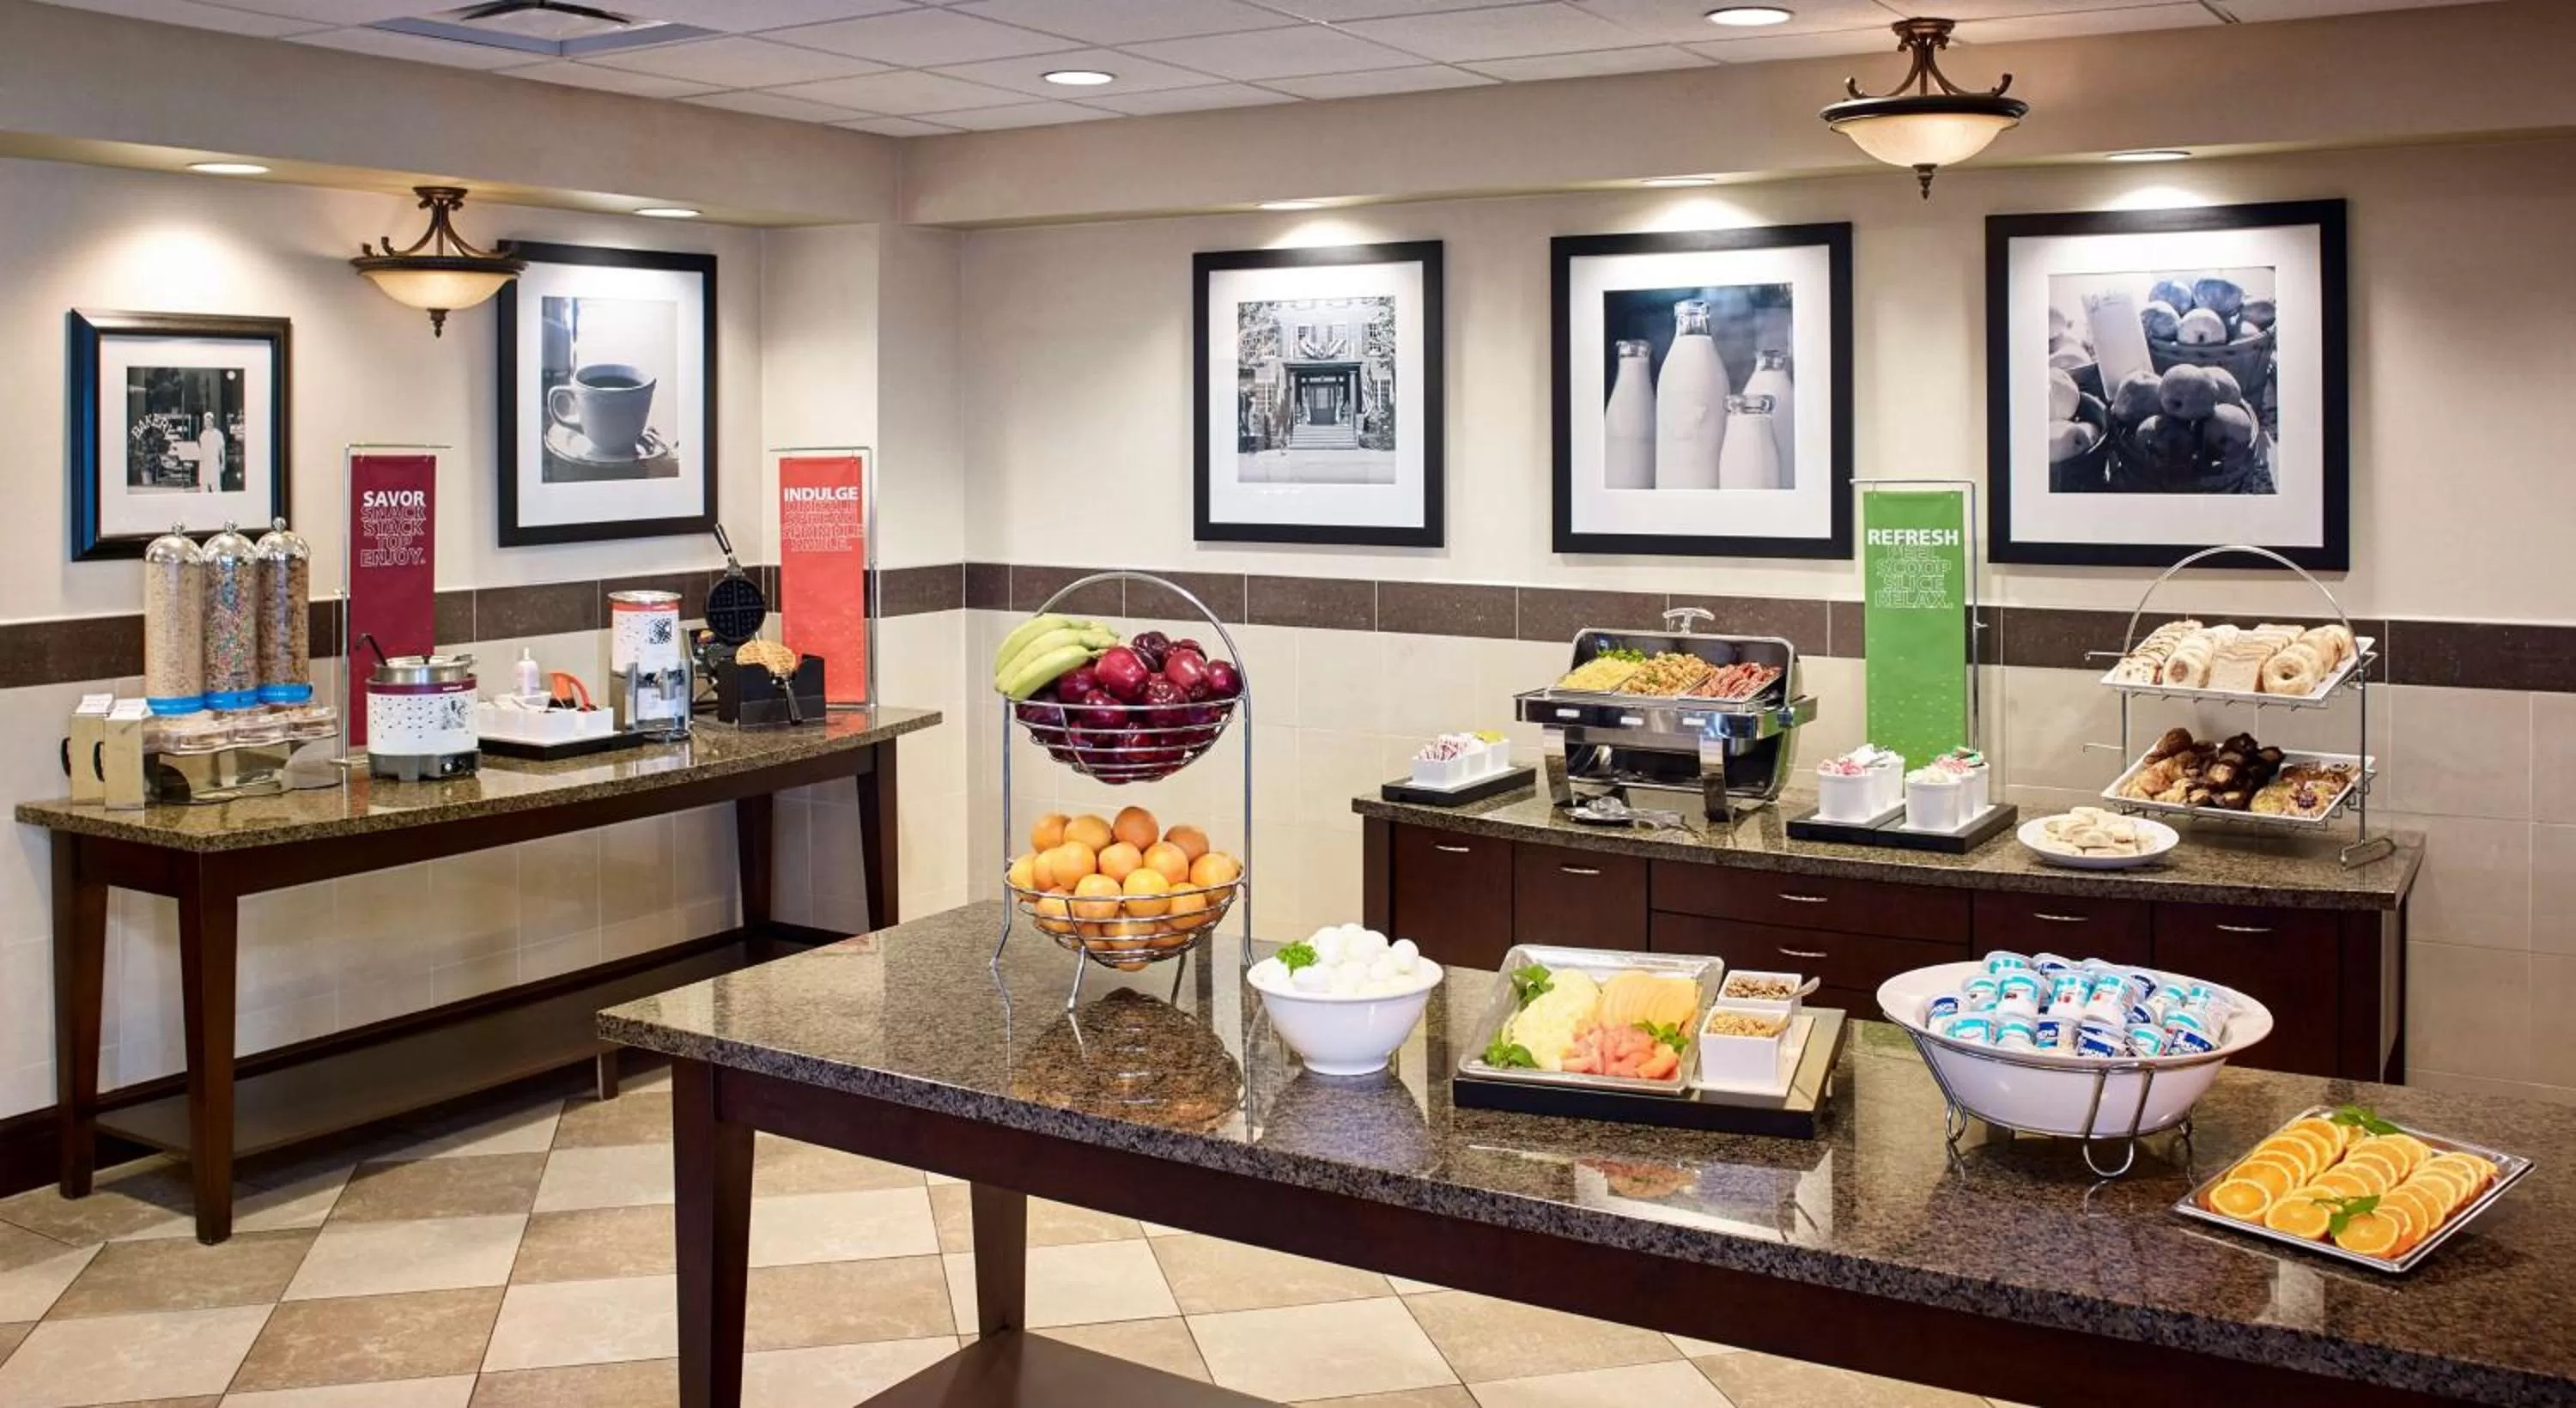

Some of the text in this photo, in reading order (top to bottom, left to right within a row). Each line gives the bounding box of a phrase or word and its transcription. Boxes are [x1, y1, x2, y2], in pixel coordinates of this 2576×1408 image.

[363, 490, 426, 507] SAVOR
[784, 487, 859, 501] INDULGE
[363, 519, 425, 536] STACK
[375, 533, 412, 549] TOP
[1868, 529, 1959, 546] REFRESH
[361, 548, 426, 567] ENJOY.
[1874, 558, 1952, 577] SCOOP
[1883, 574, 1945, 592] SLICE
[1874, 590, 1954, 609] RELAX.
